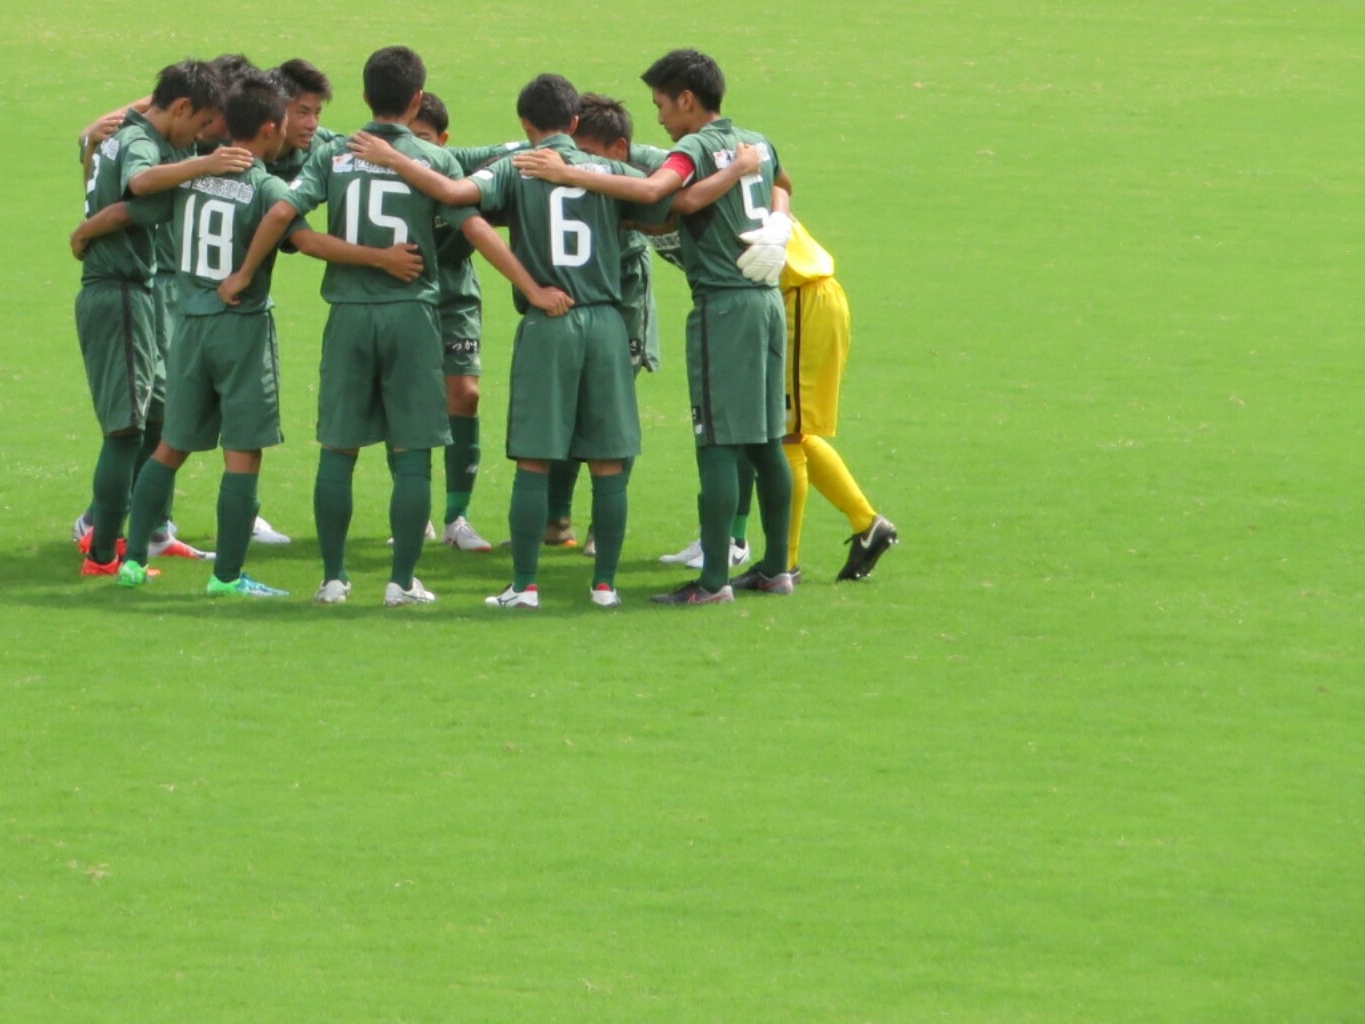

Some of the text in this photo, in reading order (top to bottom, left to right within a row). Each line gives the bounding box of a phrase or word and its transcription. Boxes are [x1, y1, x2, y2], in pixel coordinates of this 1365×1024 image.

[181, 193, 236, 281] 18
[346, 177, 412, 247] 15
[549, 185, 592, 268] 6
